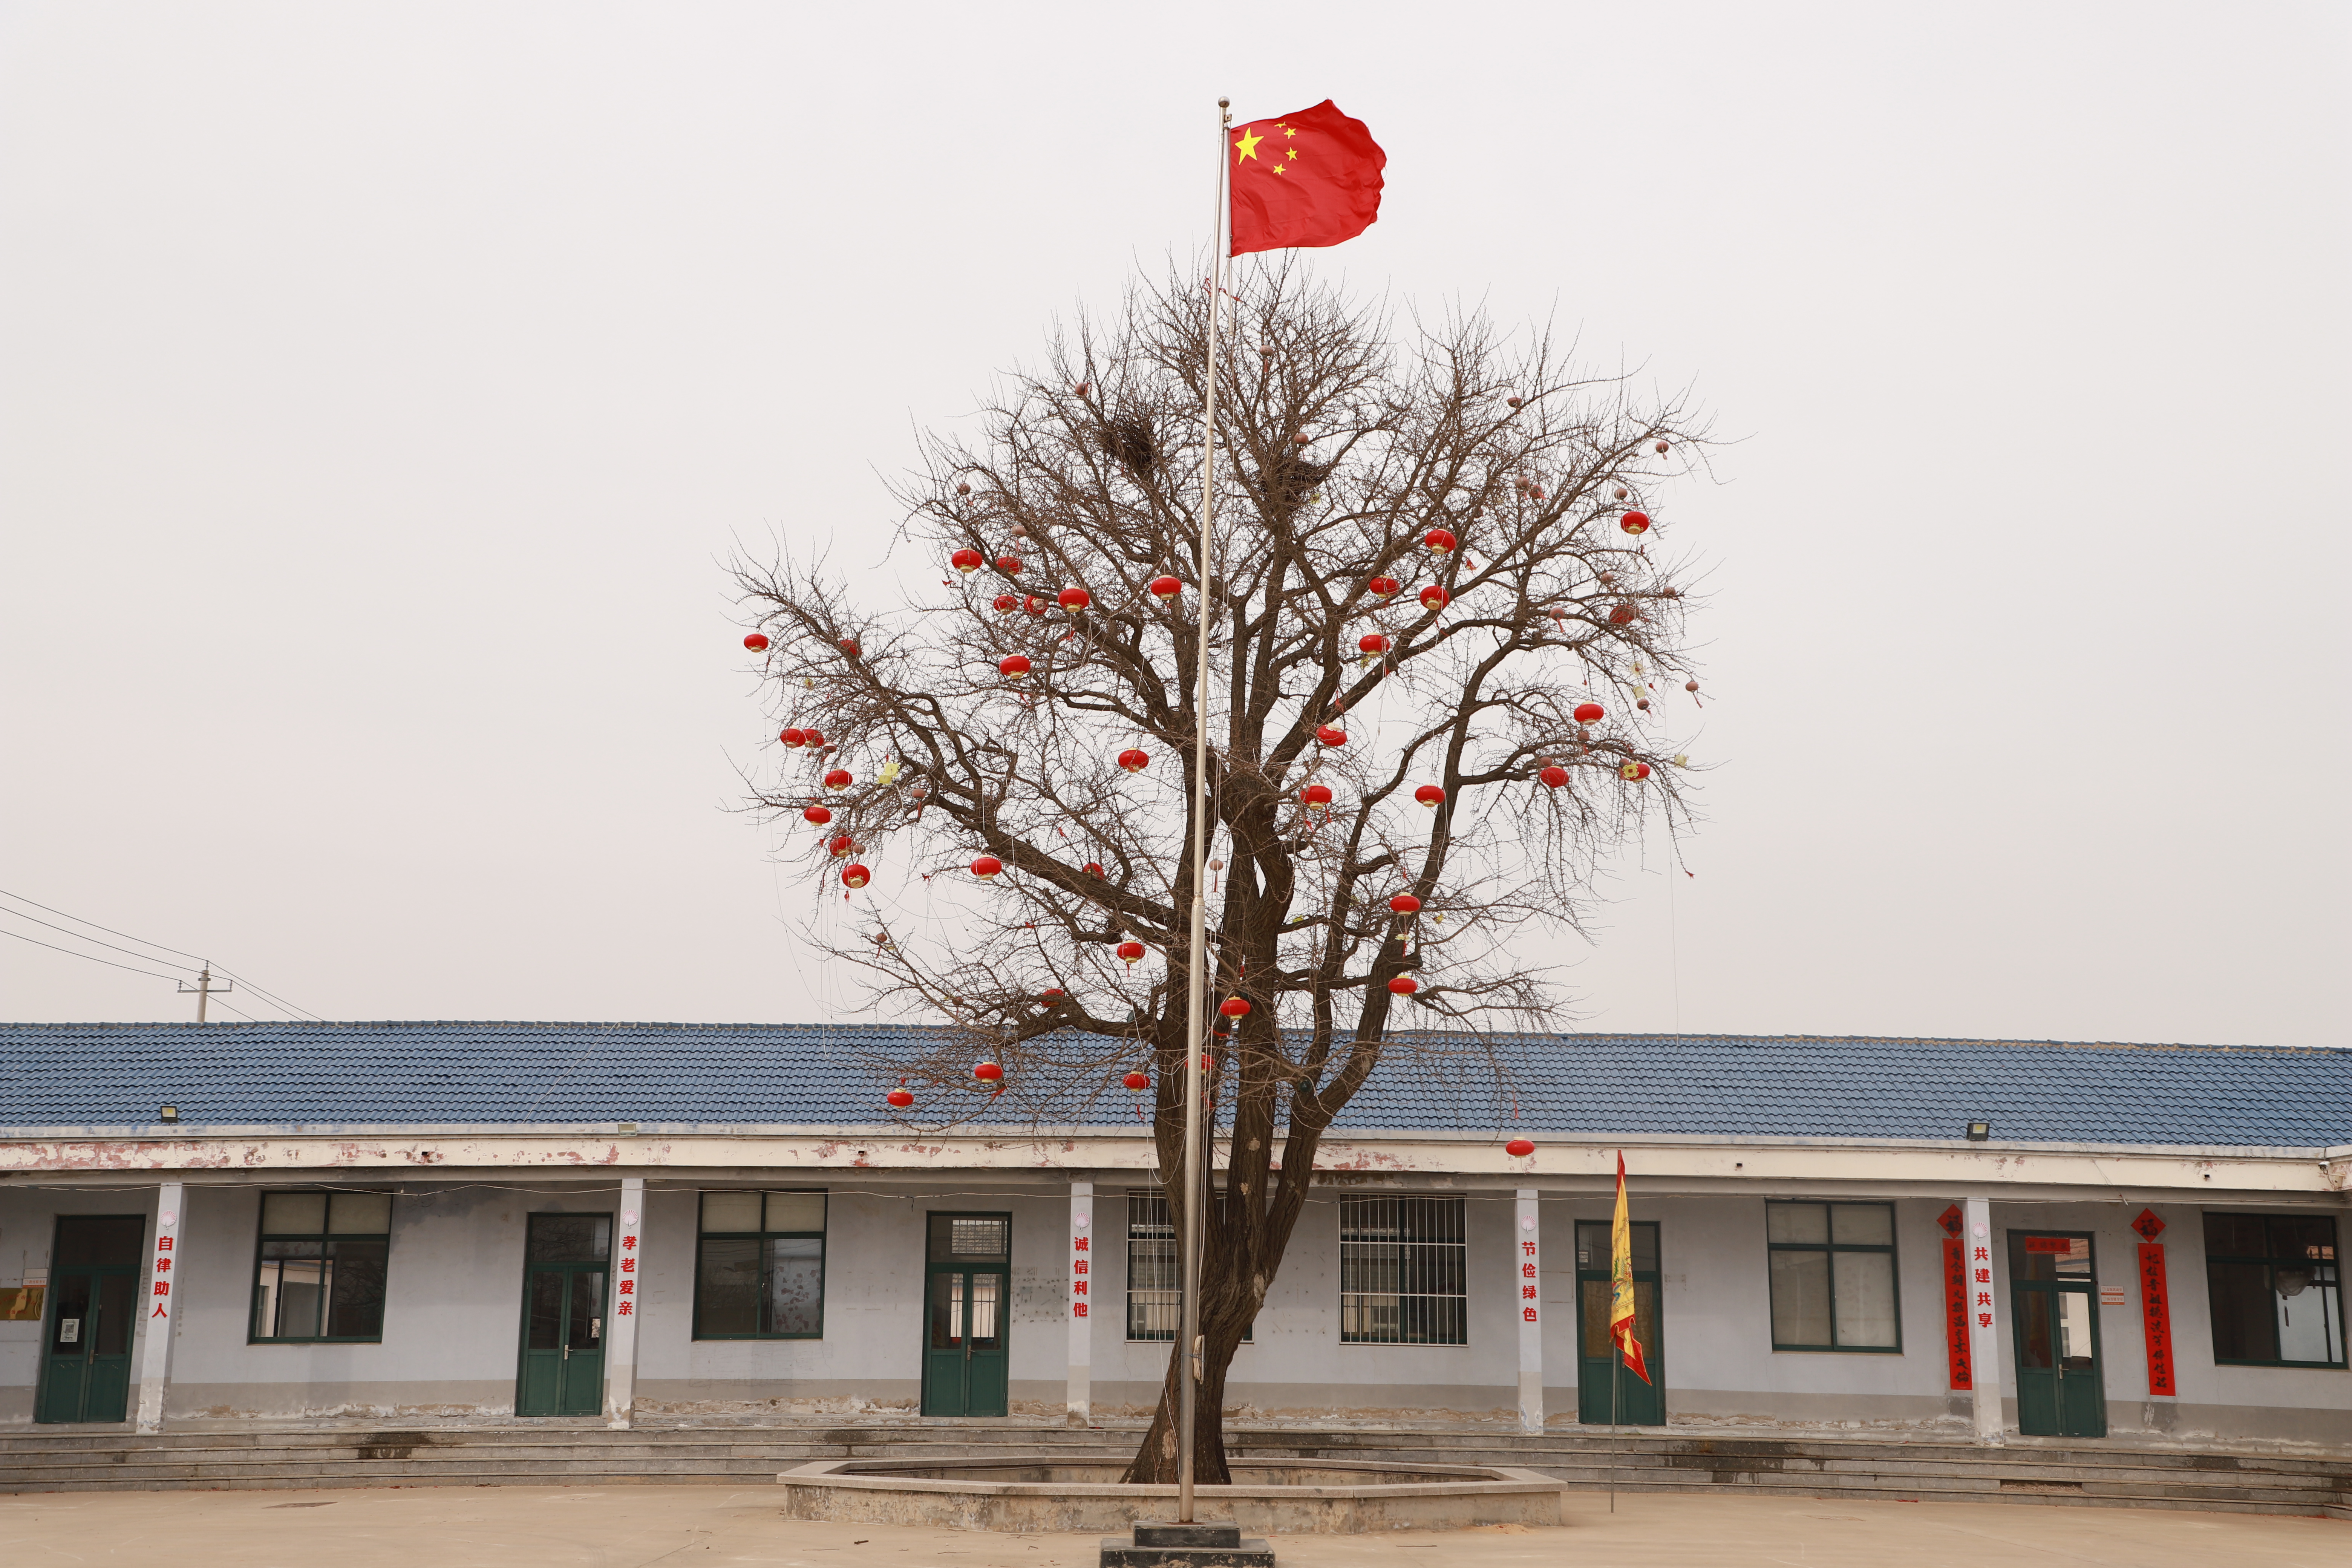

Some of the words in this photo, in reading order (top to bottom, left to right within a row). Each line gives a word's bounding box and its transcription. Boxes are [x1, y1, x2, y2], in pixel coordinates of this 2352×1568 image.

[1945, 1215, 1963, 1233] 福
[2139, 1219, 2158, 1236] 福
[152, 1236, 173, 1318] 自律助人
[618, 1236, 637, 1315] 孝老爱亲
[1073, 1237, 1089, 1318] 诚信利他
[1521, 1241, 1537, 1321] 节俭绿色
[1974, 1246, 1993, 1328] 共建共享
